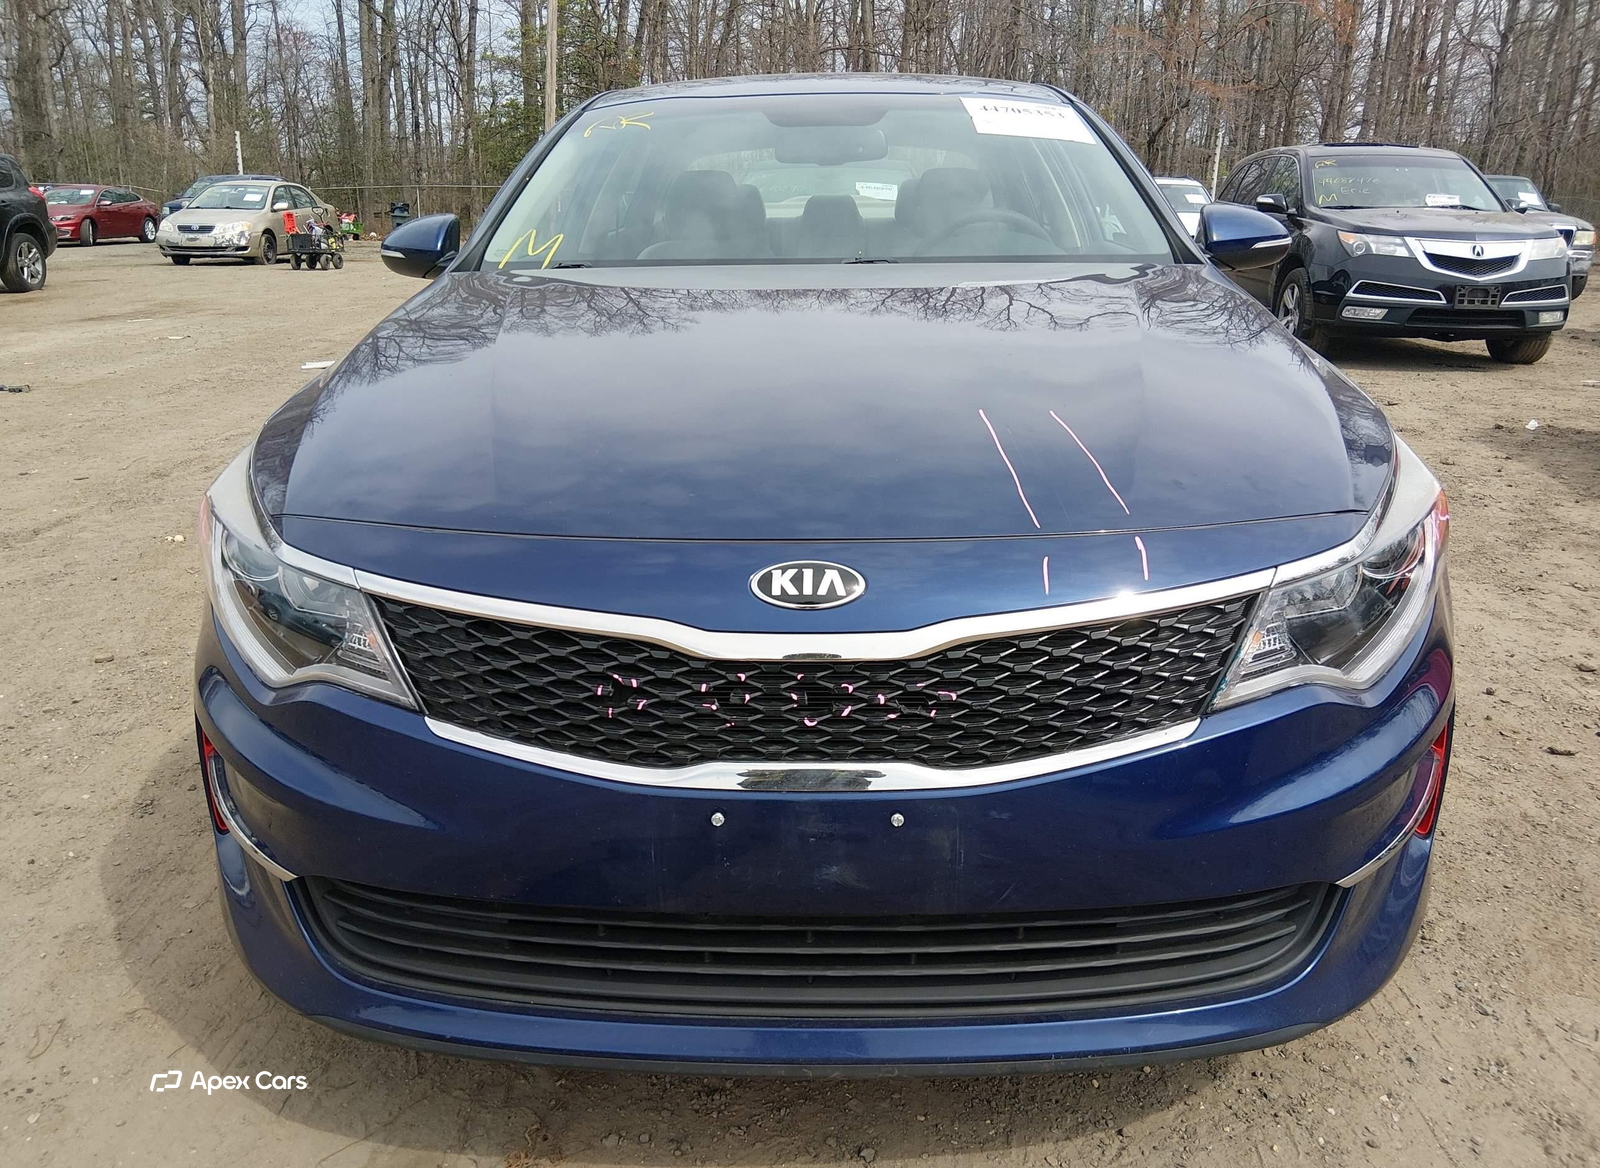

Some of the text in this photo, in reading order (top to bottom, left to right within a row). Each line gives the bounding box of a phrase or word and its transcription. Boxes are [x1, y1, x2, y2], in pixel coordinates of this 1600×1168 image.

[1318, 193, 1338, 205] M
[498, 228, 565, 270] M
[770, 568, 847, 596] KIA
